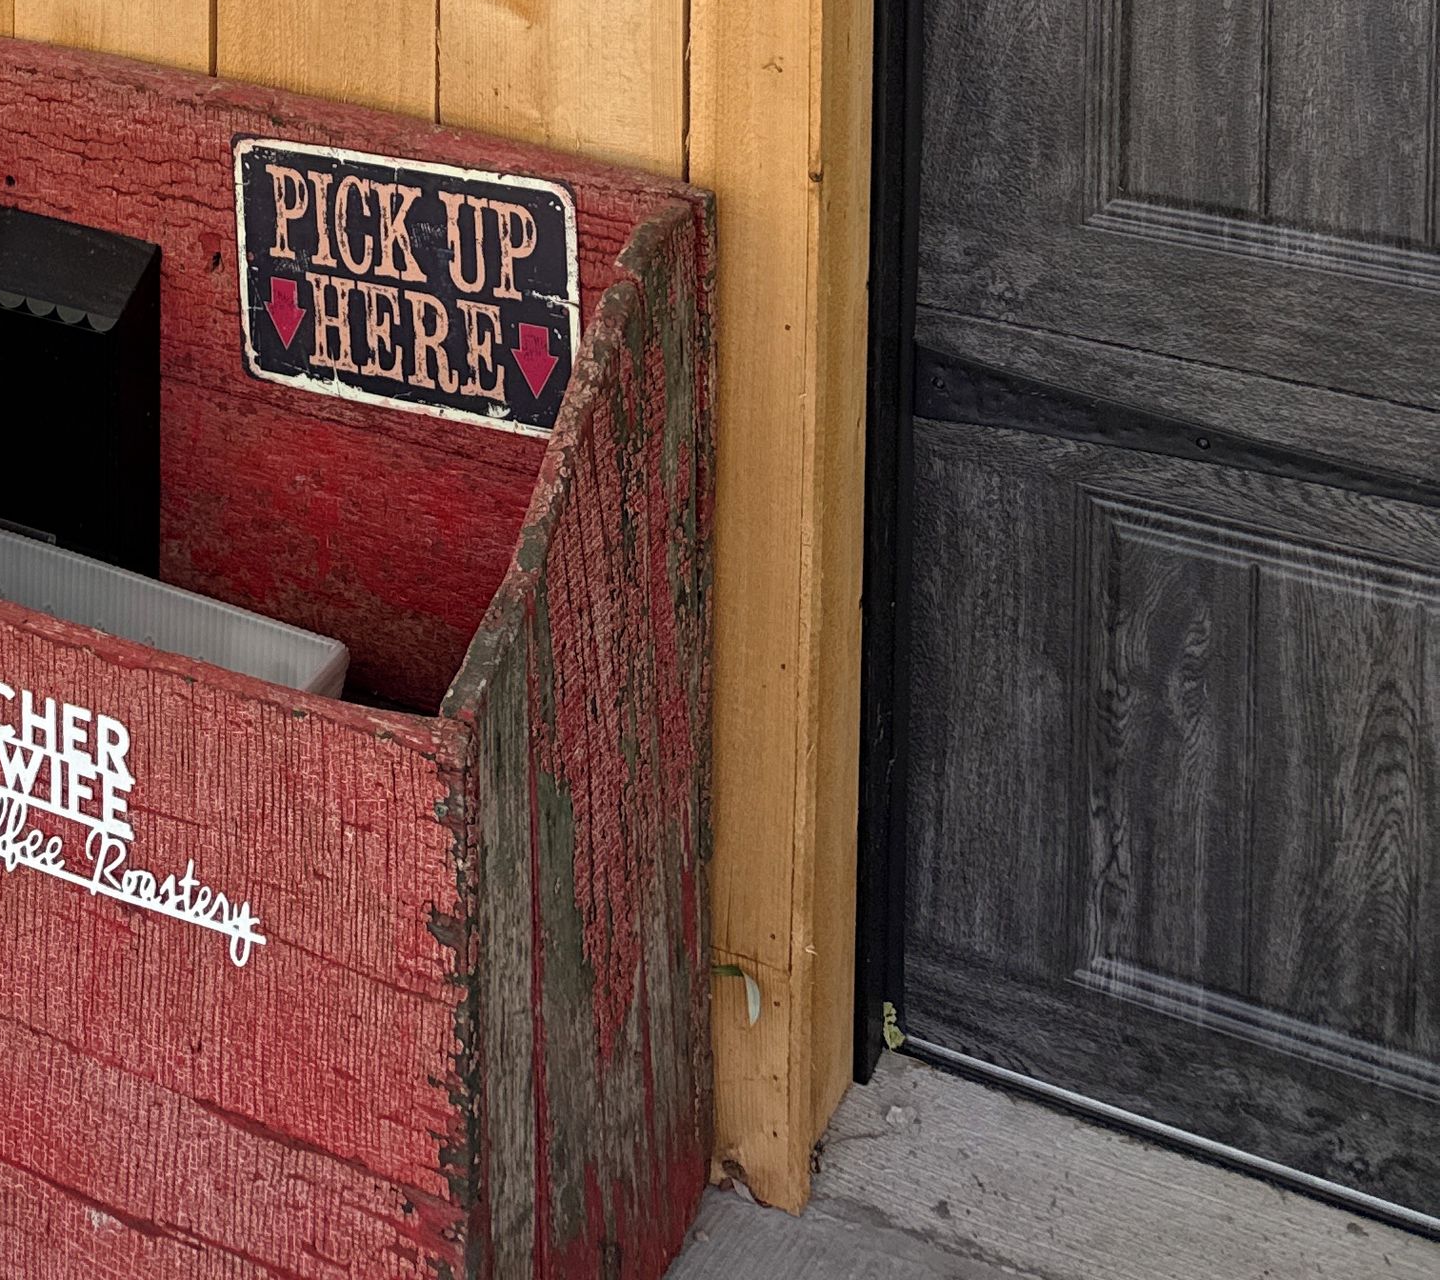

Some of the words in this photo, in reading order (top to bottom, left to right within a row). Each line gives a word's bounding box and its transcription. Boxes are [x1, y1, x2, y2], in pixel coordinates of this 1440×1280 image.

[265, 164, 428, 283] PICK
[438, 191, 537, 301] UP
[306, 272, 506, 402] HERE
[85, 826, 267, 967] Roastery
